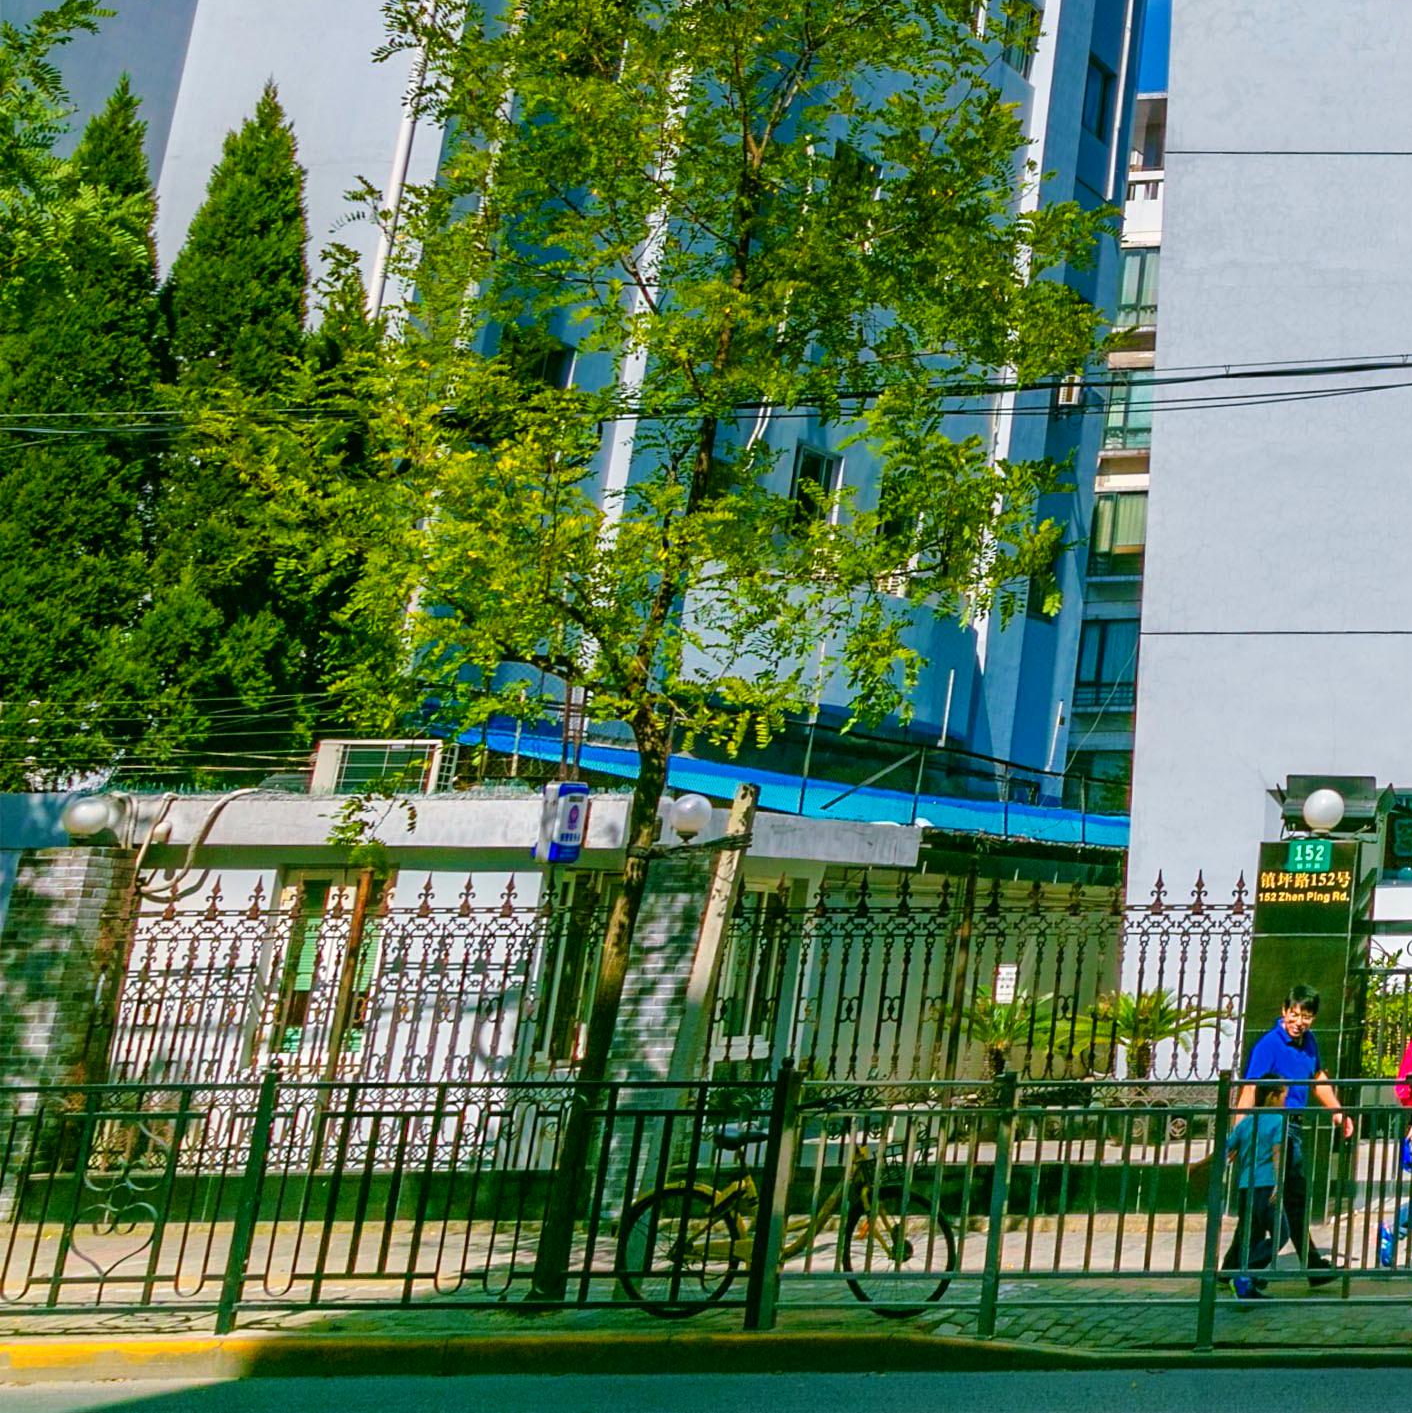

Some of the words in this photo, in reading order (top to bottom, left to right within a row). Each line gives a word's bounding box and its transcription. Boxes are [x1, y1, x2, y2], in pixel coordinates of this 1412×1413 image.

[1294, 844, 1325, 861] 152
[1261, 871, 1351, 889] 镇坪路152号
[1259, 892, 1277, 902] 152
[1278, 892, 1305, 902] Zhen
[1306, 891, 1331, 904] Ping
[1332, 891, 1350, 902] Rd.
